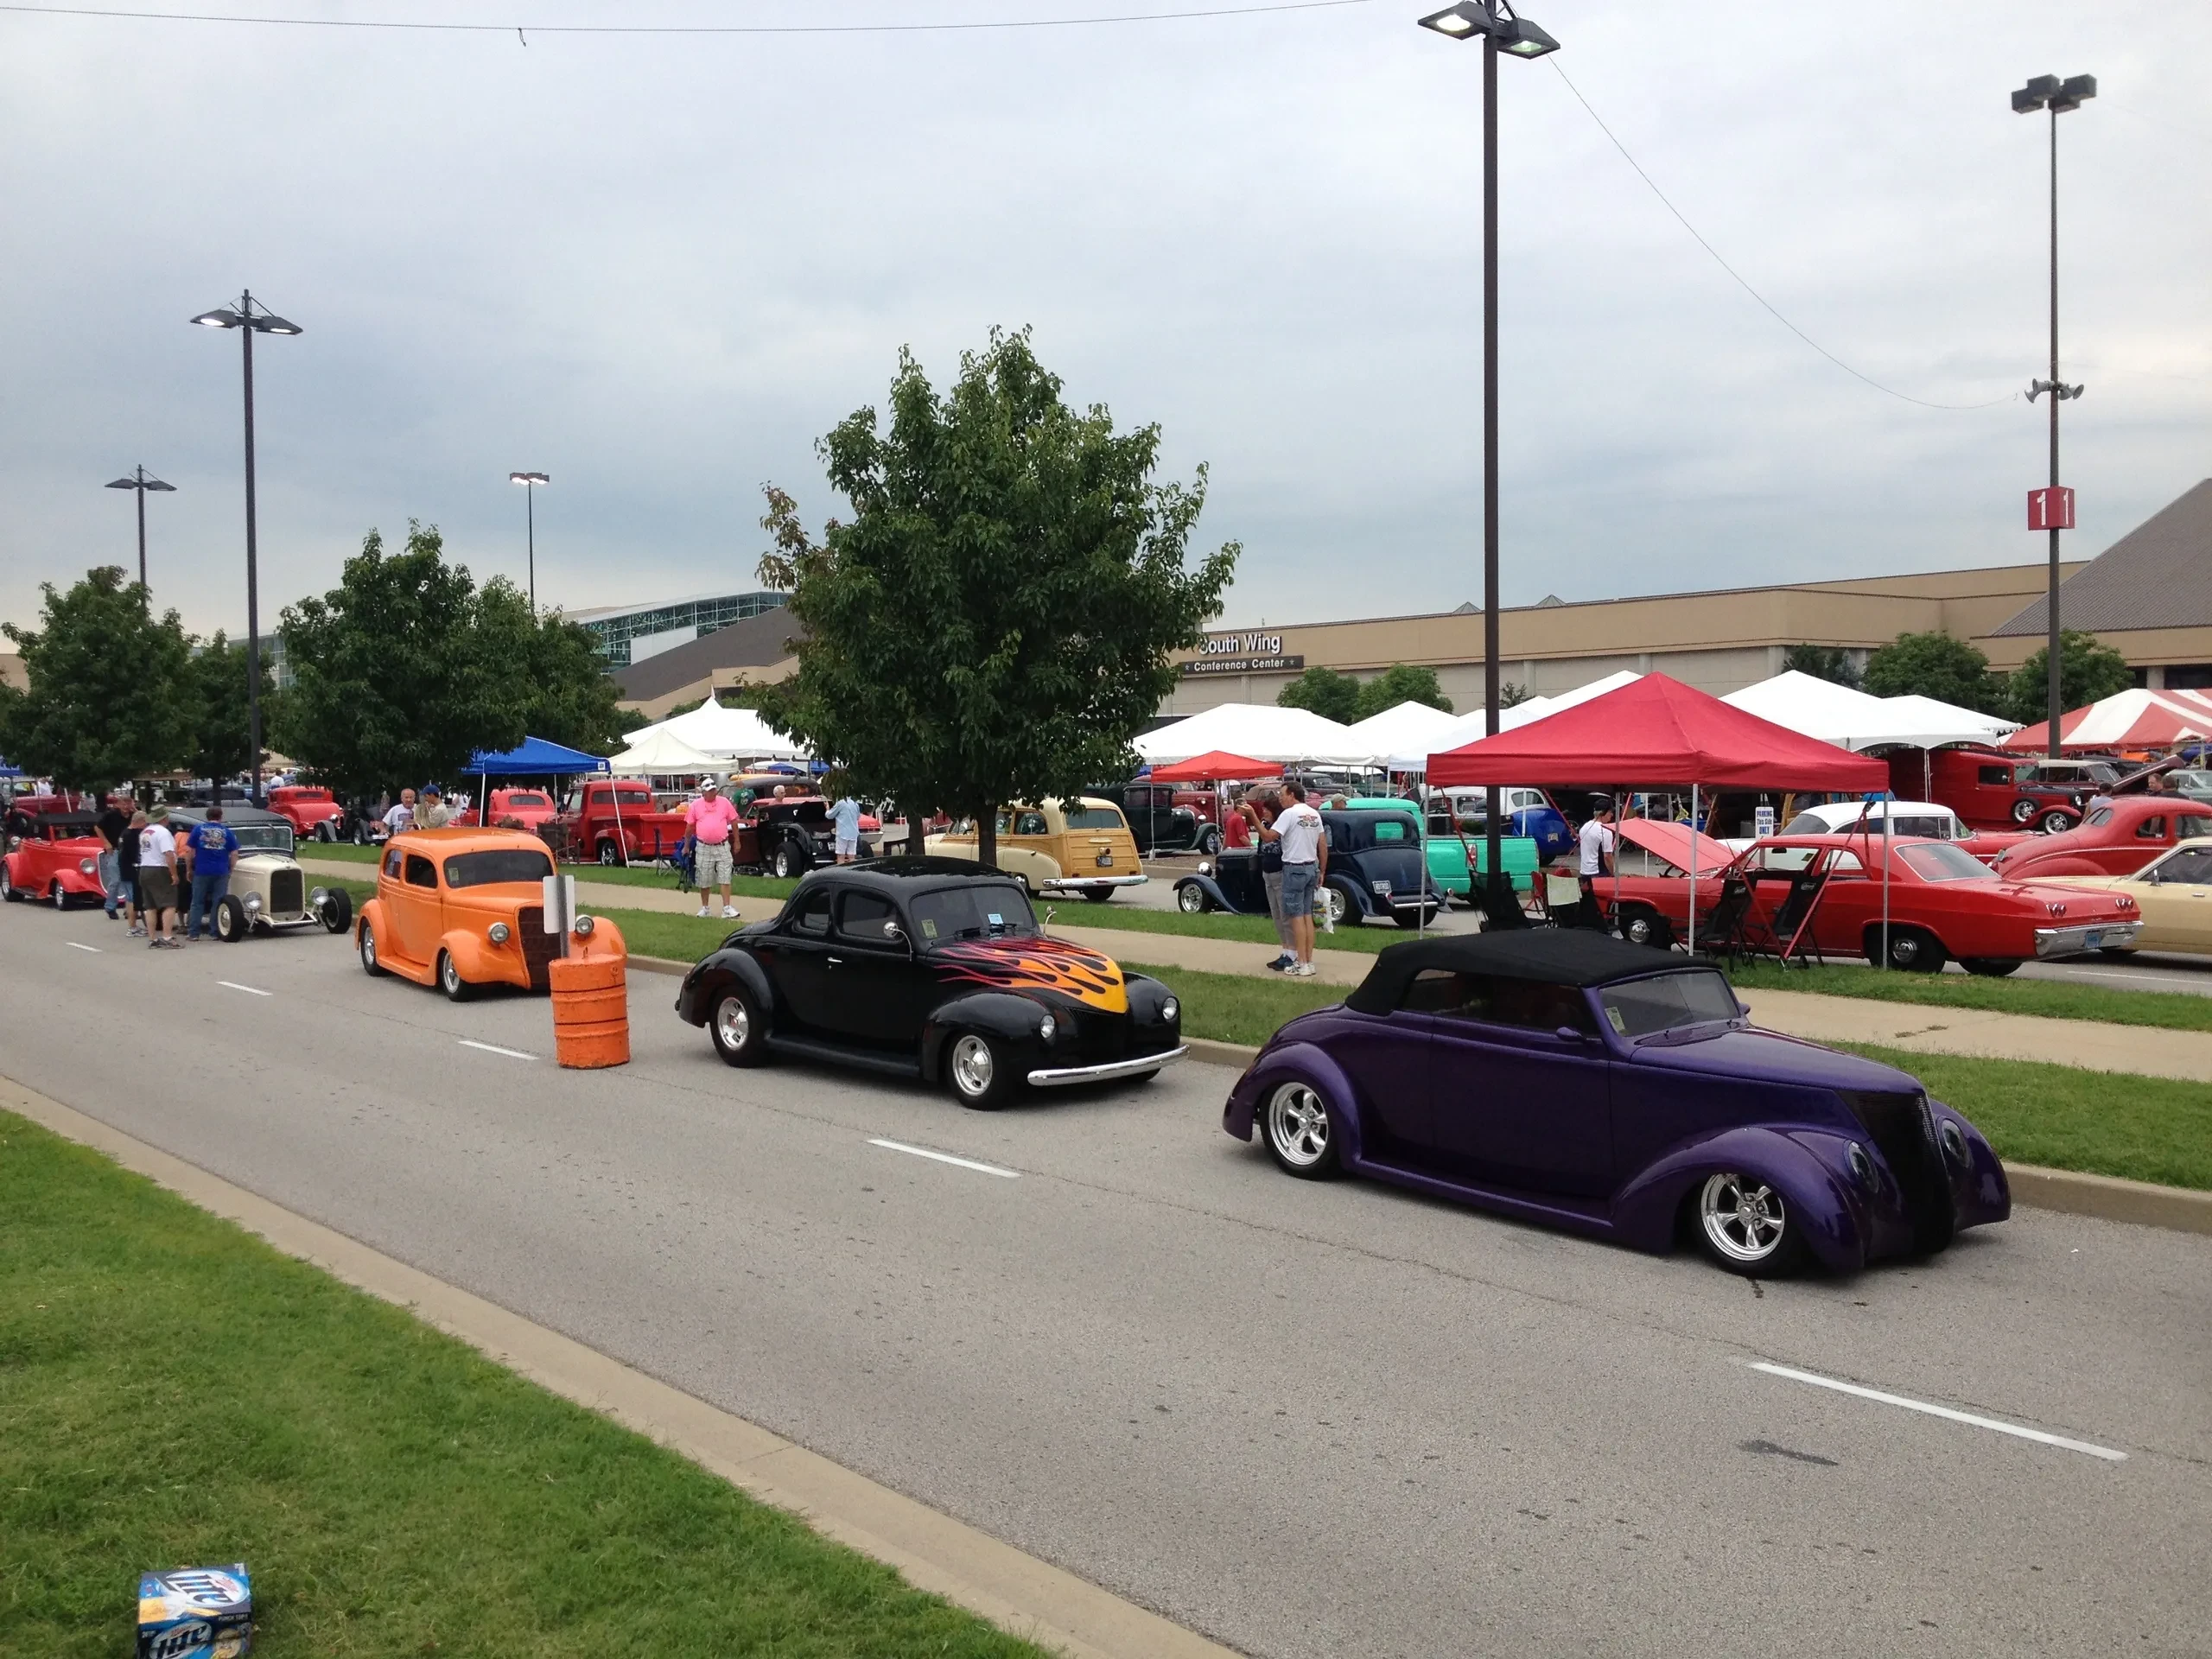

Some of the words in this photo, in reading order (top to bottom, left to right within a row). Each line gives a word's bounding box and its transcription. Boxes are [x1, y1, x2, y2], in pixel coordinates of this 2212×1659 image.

[2037, 491, 2046, 525] 1
[2063, 490, 2069, 524] 1
[1198, 635, 1240, 655] South
[1243, 633, 1281, 654] Wing
[1194, 660, 1247, 671] Conference
[1251, 658, 1284, 668] Center
